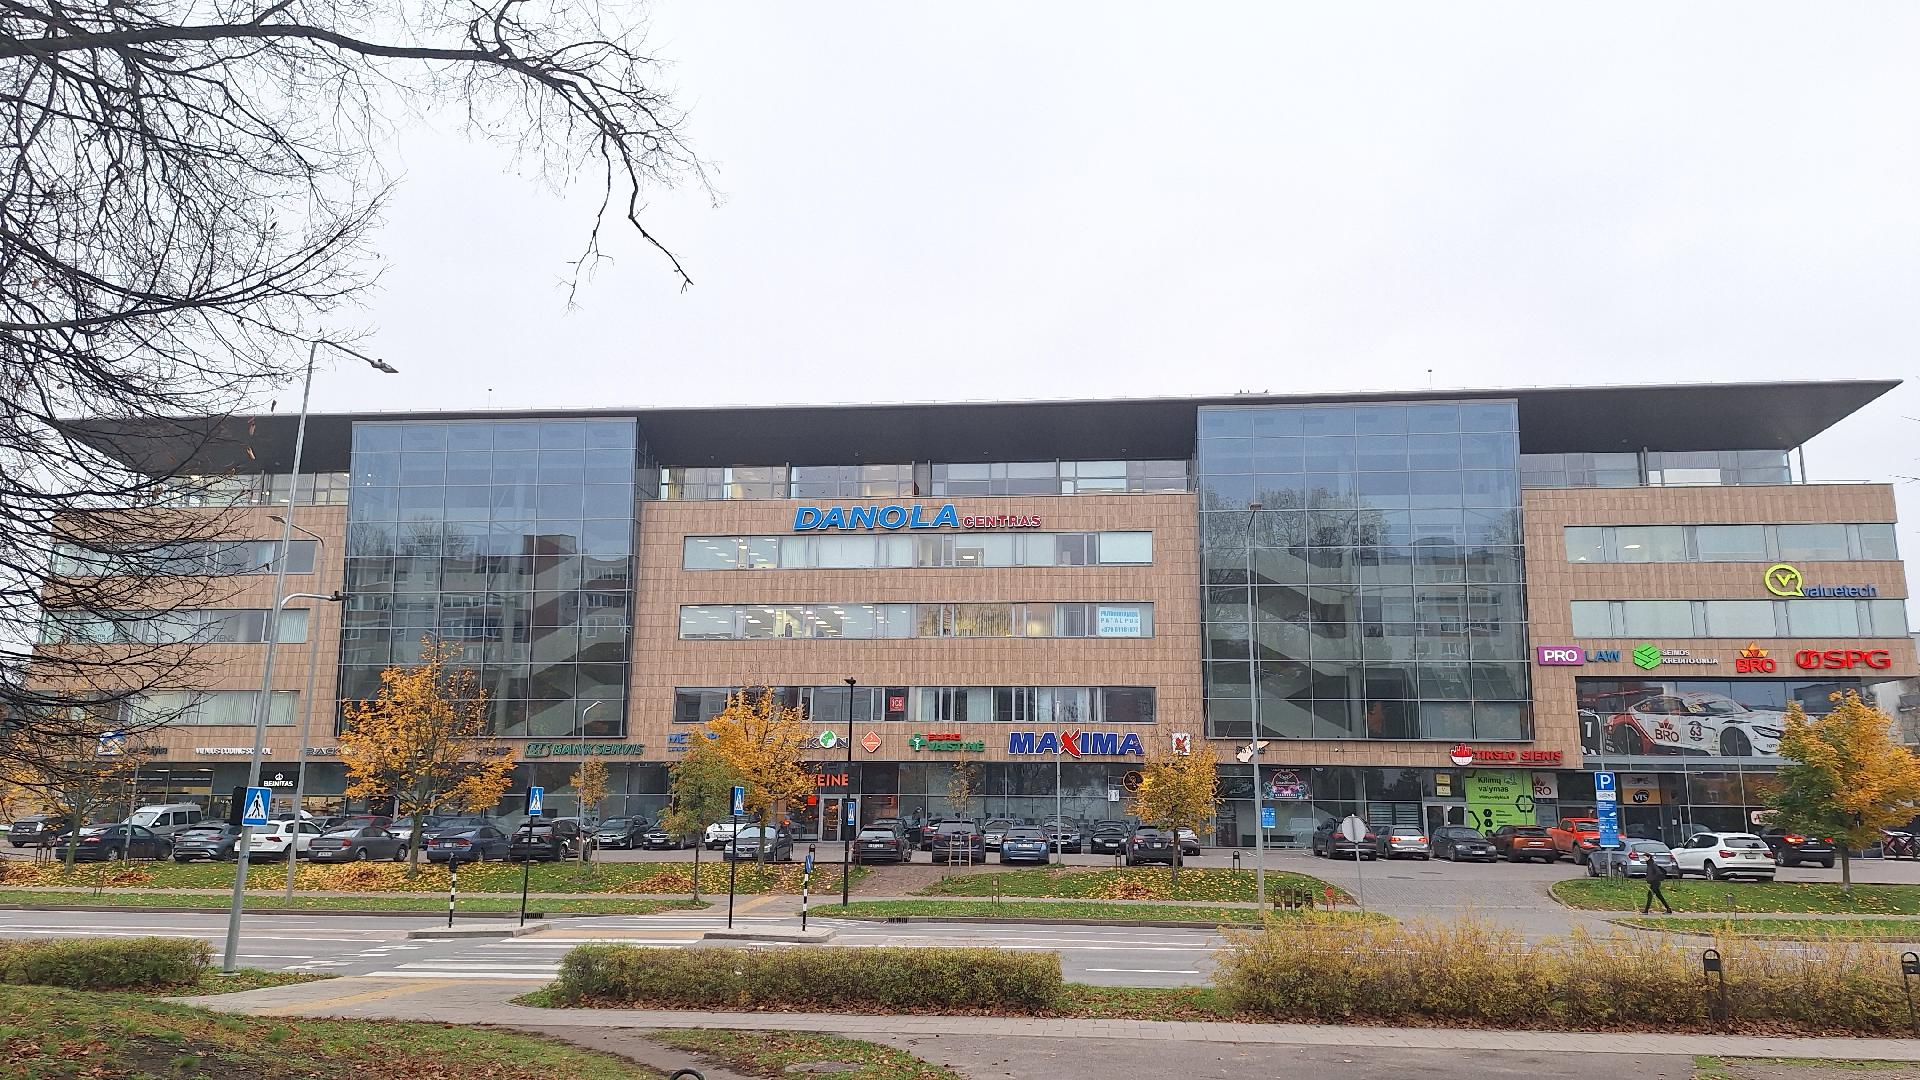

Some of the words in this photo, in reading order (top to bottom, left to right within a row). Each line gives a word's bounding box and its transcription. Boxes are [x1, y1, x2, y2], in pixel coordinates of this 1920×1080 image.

[793, 504, 960, 531] DANOLA
[962, 515, 1042, 529] CENTRAS
[1804, 584, 1876, 598] valuetech
[1543, 649, 1578, 662] PRO
[1584, 650, 1621, 663] LAW
[1823, 649, 1892, 669] SPG
[1735, 658, 1777, 673] BRO
[1584, 721, 1593, 738] 1
[1655, 728, 1680, 743] BRO
[1689, 726, 1702, 737] 63
[1008, 728, 1145, 758] MAXIMA
[246, 747, 272, 755] SCOL
[1600, 774, 1611, 790] P
[1534, 786, 1552, 796] RO
